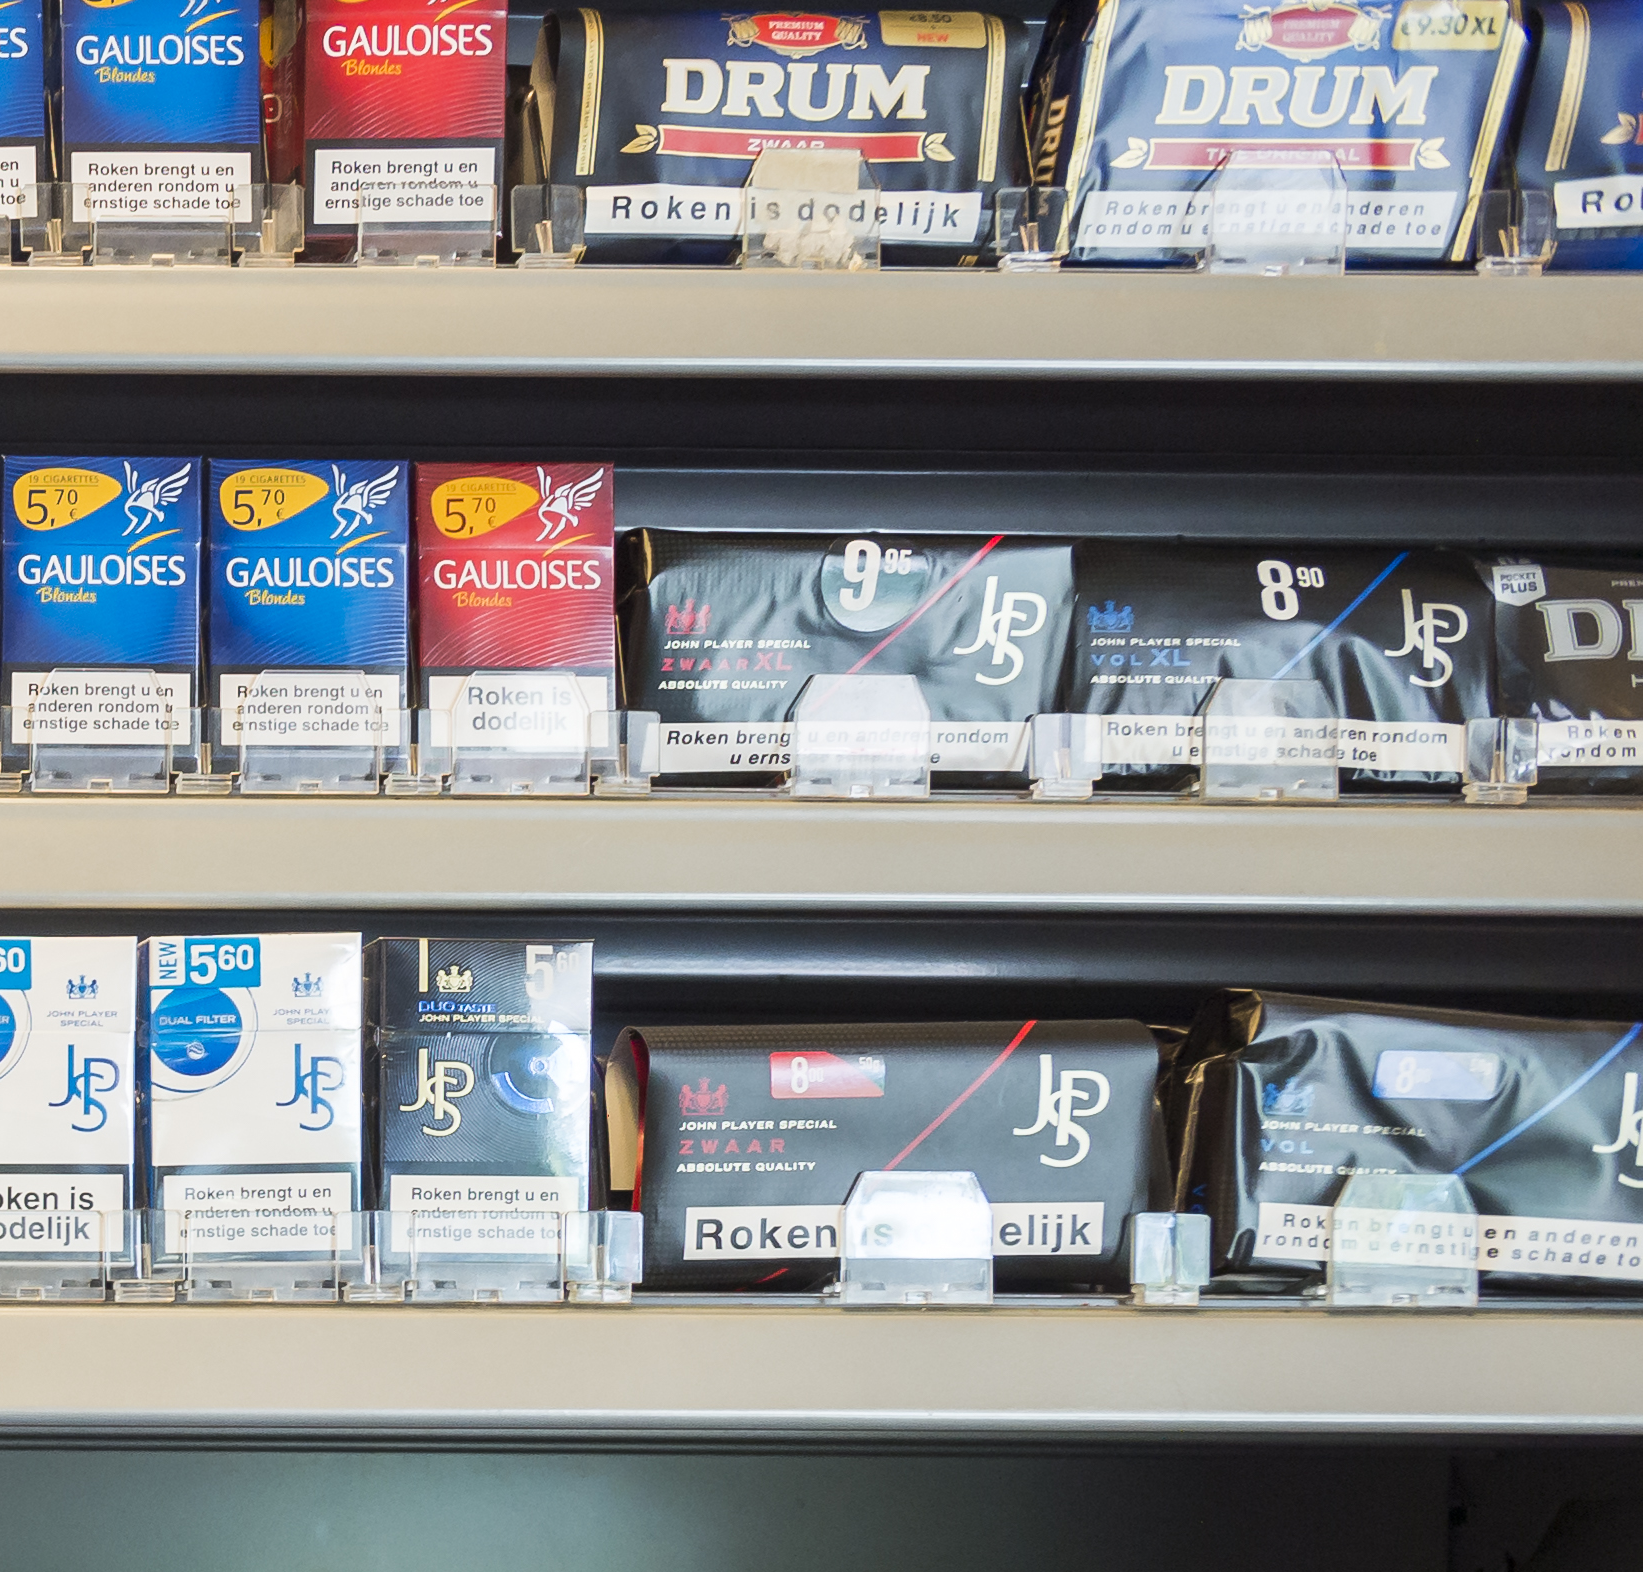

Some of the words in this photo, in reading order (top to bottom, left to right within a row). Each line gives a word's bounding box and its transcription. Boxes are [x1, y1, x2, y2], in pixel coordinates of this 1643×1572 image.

[323, 24, 493, 60] GAULOISES
[771, 30, 823, 41] QUALITY
[341, 59, 403, 78] Blondes
[661, 59, 930, 121] DRUM
[1, 161, 19, 174] en
[434, 560, 600, 590] GAULOISES
[453, 591, 512, 607] Blondes
[664, 640, 699, 650] JOHN
[703, 640, 753, 649] PLAYER
[758, 639, 812, 649] SPECIAL
[658, 680, 728, 690] ABSOLUTE
[731, 680, 789, 690] QUALITY
[678, 1139, 785, 1154] ZWAAR
[69, 1187, 94, 1210] is
